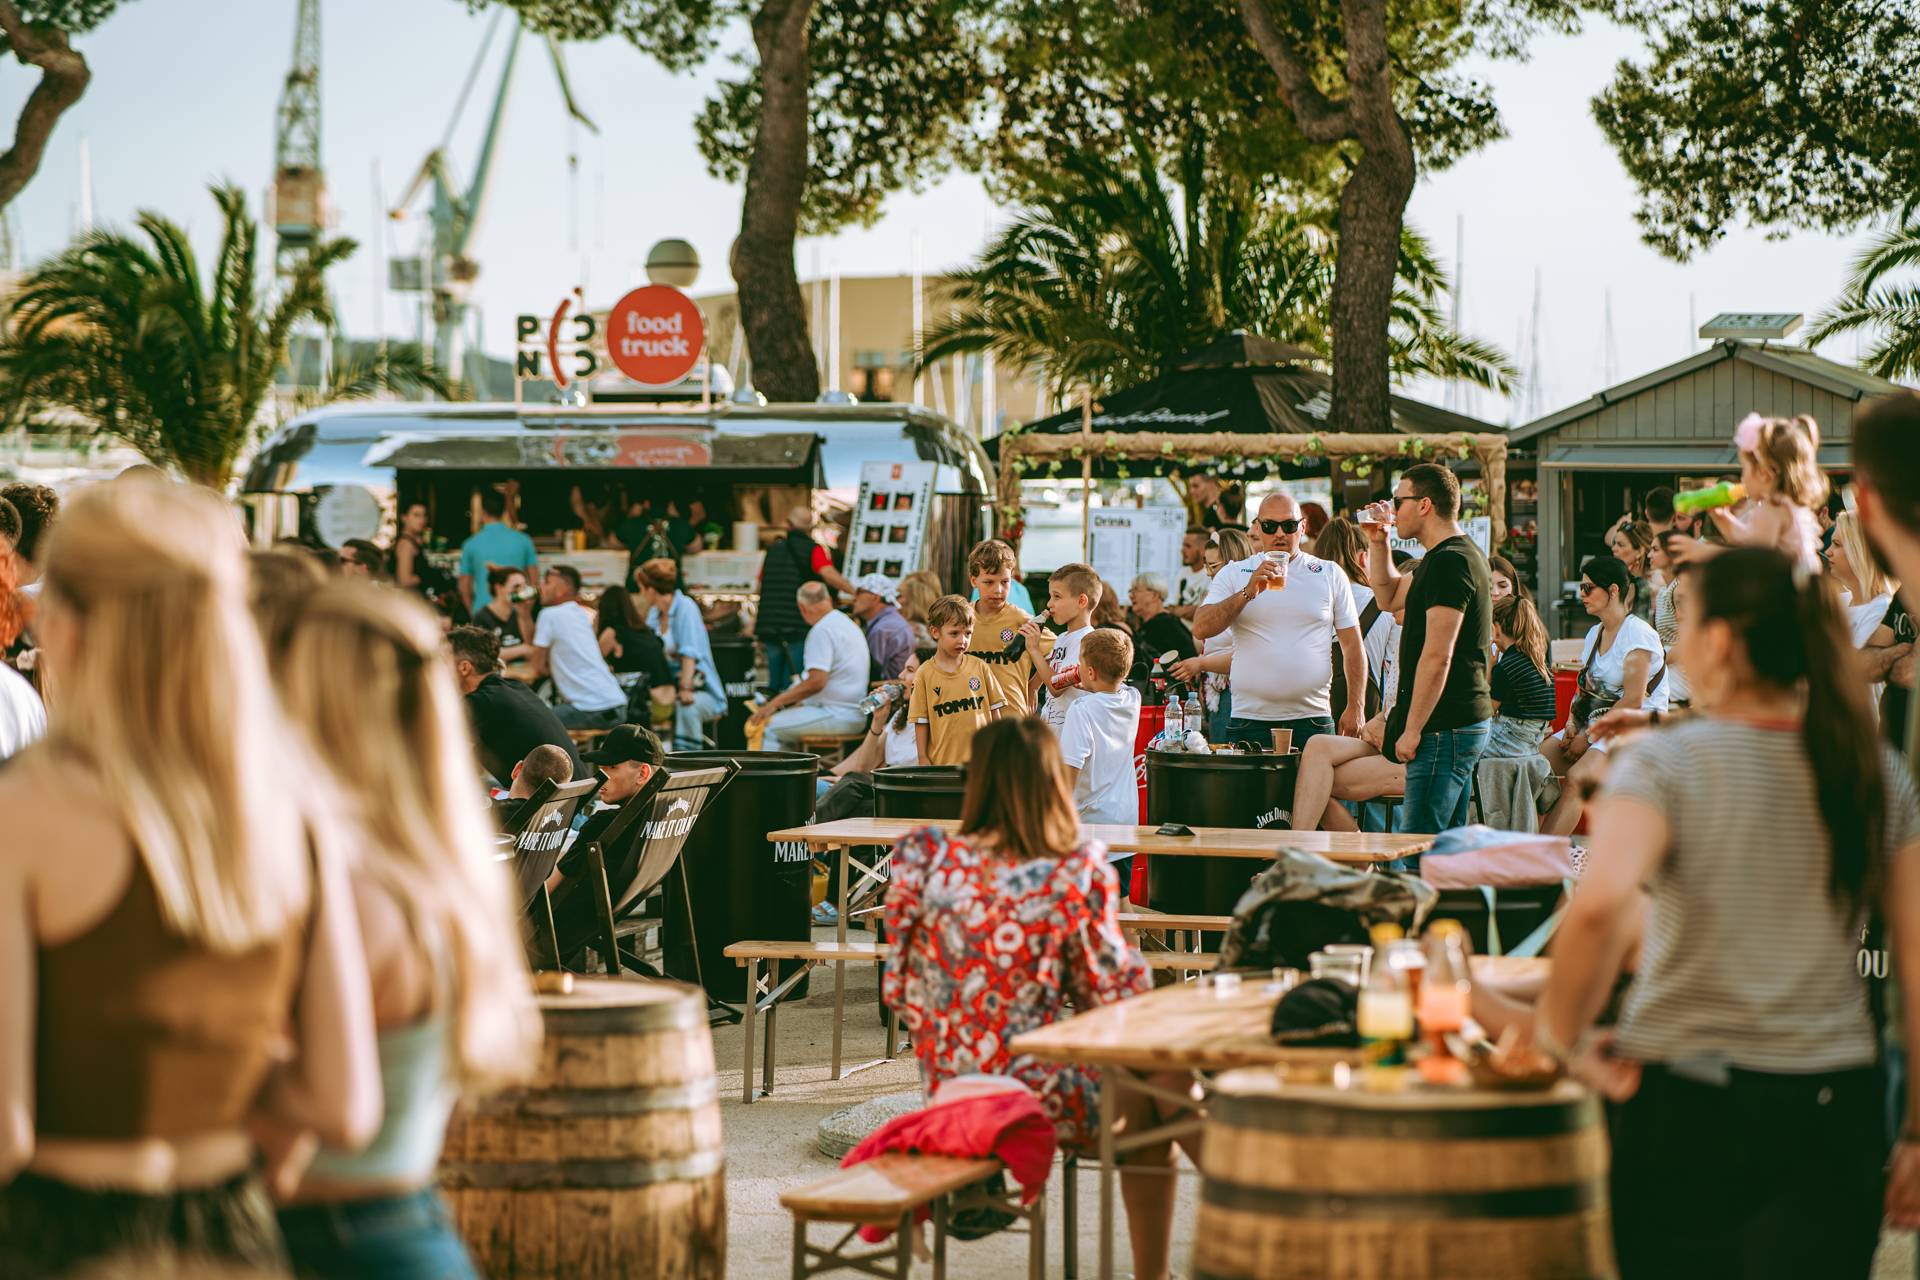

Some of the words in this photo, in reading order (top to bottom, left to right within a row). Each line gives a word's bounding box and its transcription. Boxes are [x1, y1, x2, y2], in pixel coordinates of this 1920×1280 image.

[627, 312, 683, 334] food
[621, 336, 690, 356] truck
[933, 696, 984, 717] TOMMY
[1256, 810, 1274, 828] JACK
